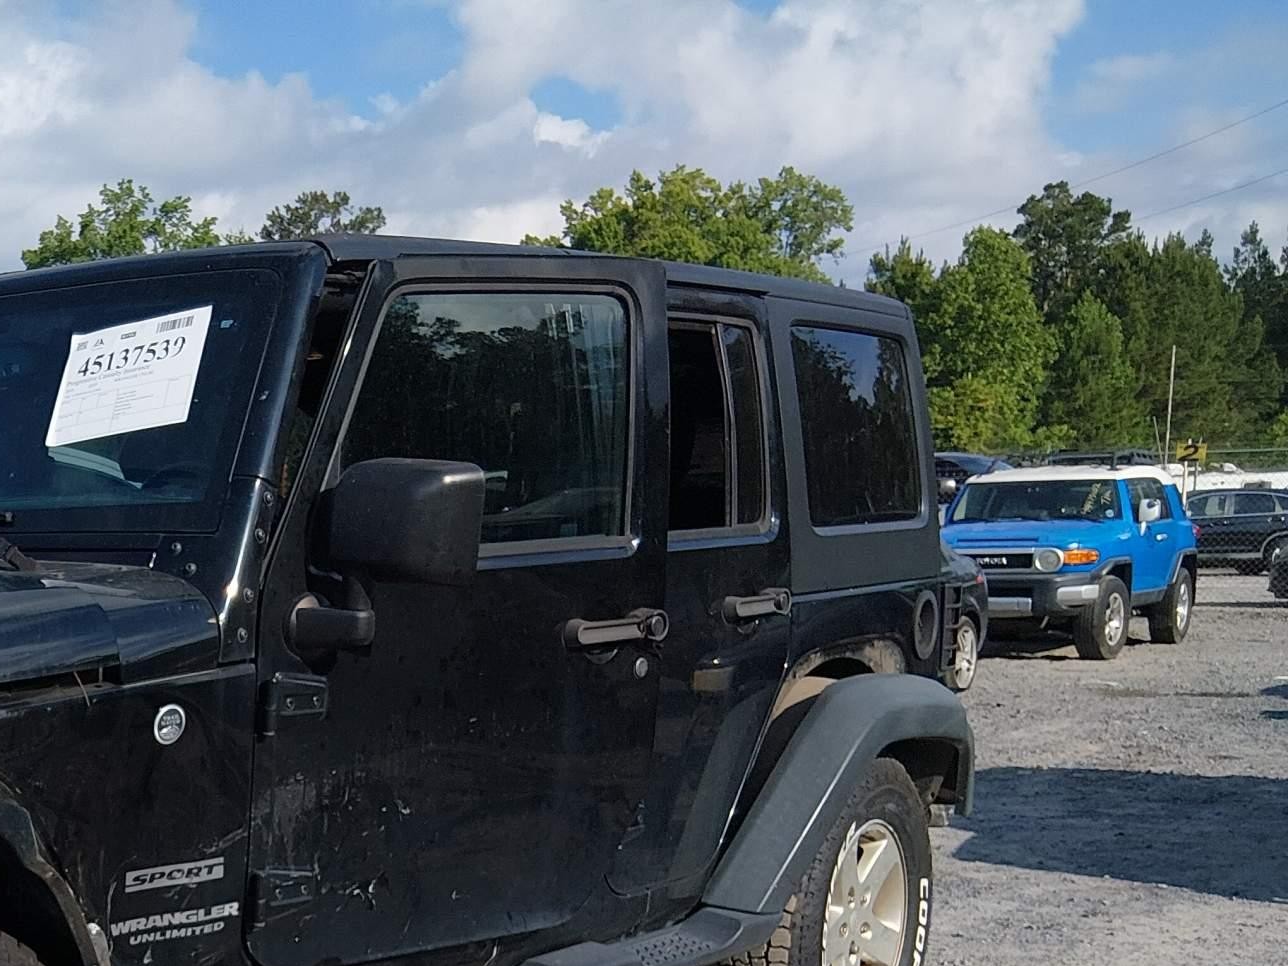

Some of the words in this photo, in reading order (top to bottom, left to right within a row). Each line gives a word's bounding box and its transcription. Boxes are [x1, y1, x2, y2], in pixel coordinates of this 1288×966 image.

[78, 337, 186, 377] 45137539
[1178, 444, 1199, 461] 2
[129, 862, 223, 887] SPORT
[111, 901, 239, 936] WRANGLER
[129, 921, 224, 945] UNLIMITED
